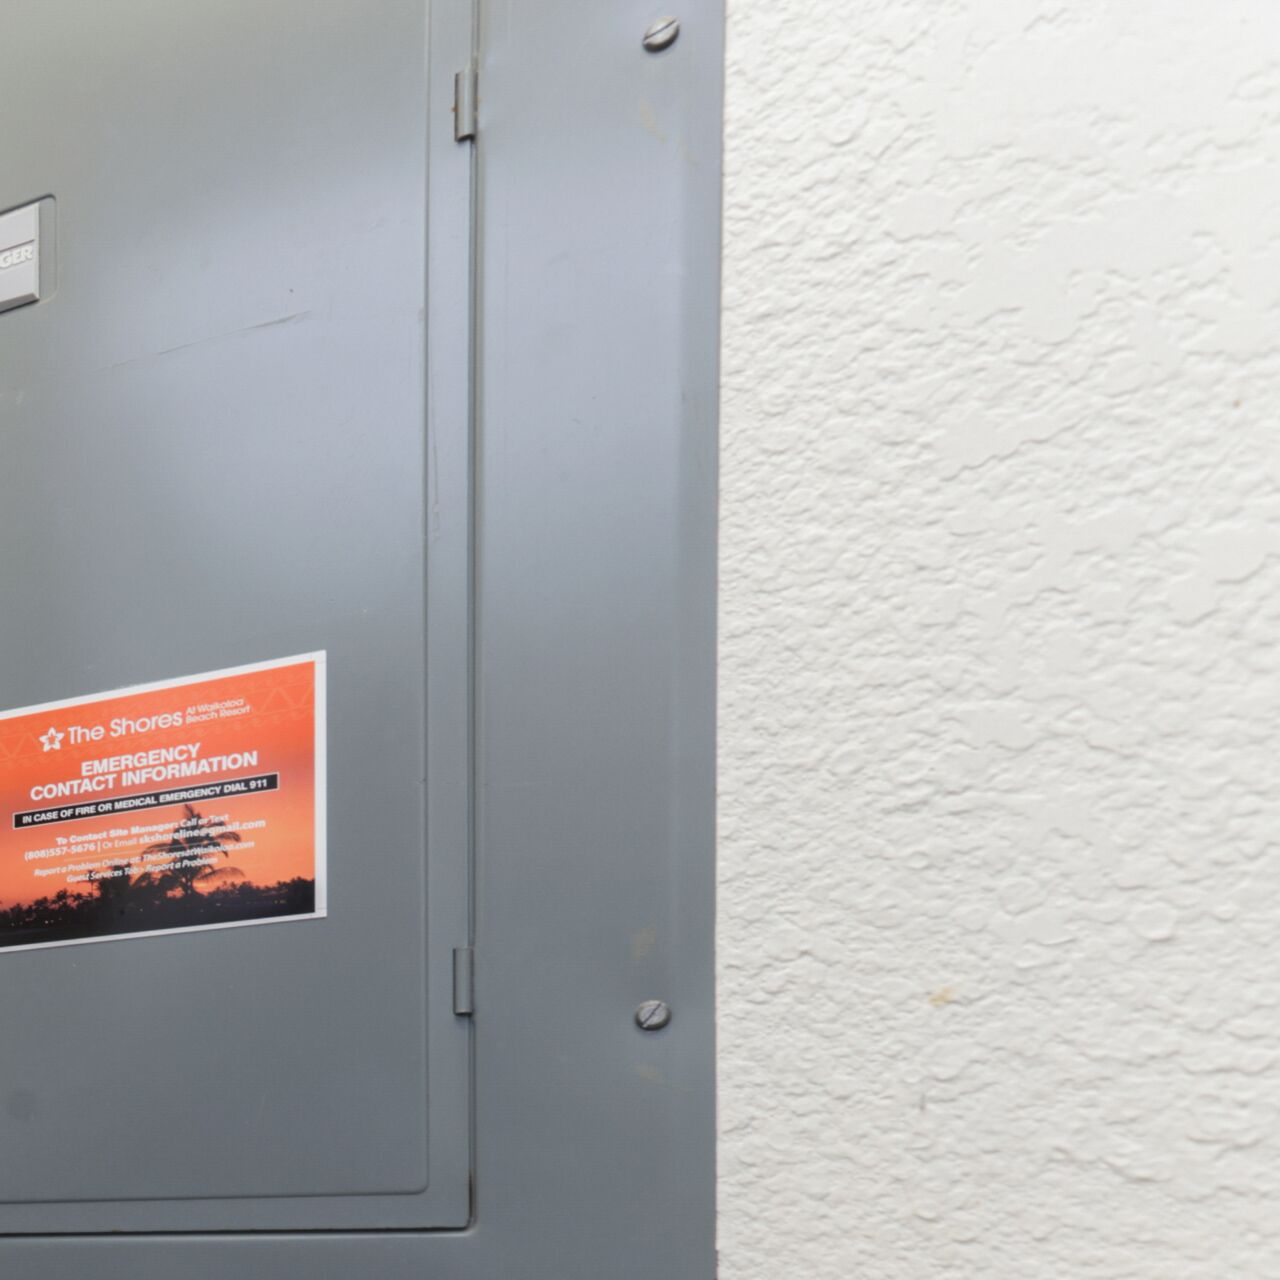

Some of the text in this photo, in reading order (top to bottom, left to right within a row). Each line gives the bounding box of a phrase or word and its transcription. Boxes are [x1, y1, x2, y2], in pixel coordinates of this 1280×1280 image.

[186, 704, 251, 723] Beach Resort
[197, 698, 244, 712] Waikoloa
[68, 710, 183, 745] The Shores
[80, 743, 201, 777] EMERGENCY
[30, 751, 258, 802] CONTACT INFORMATION
[22, 778, 268, 824] IN CASE OF FIRE OR MEDICAL EMERGENCY DIAL 911
[56, 813, 230, 846] To Contact Site Manager: Call or Text
[102, 840, 113, 848] Or
[114, 838, 138, 848] Email
[34, 866, 58, 877] Report
[66, 862, 102, 872] Problem
[102, 858, 129, 867] Online
[66, 872, 90, 883] Guest
[90, 868, 123, 880] Services
[146, 862, 174, 873] Report
[182, 856, 218, 868] Problem
